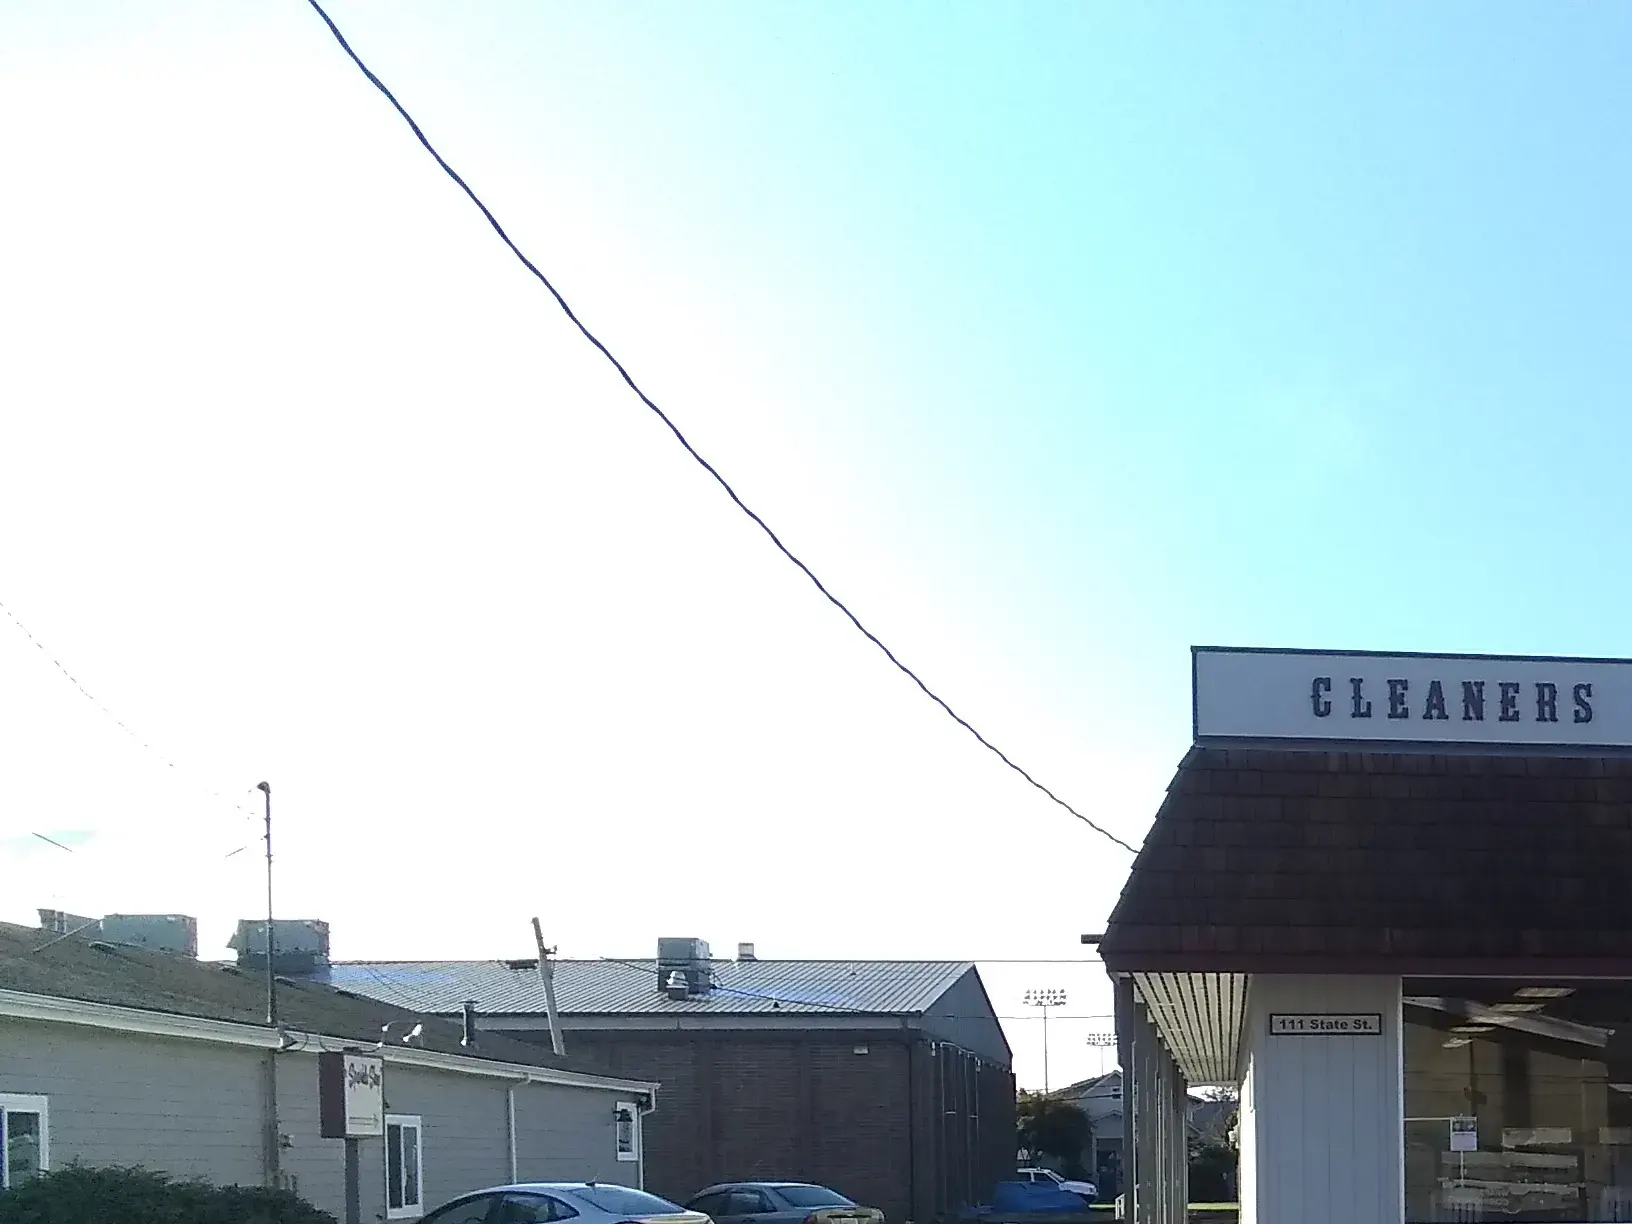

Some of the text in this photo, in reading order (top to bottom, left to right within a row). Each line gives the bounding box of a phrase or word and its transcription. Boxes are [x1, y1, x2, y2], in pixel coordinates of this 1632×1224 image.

[1310, 676, 1594, 724] CLEANERS
[1279, 1019, 1373, 1030] 111 State St.
